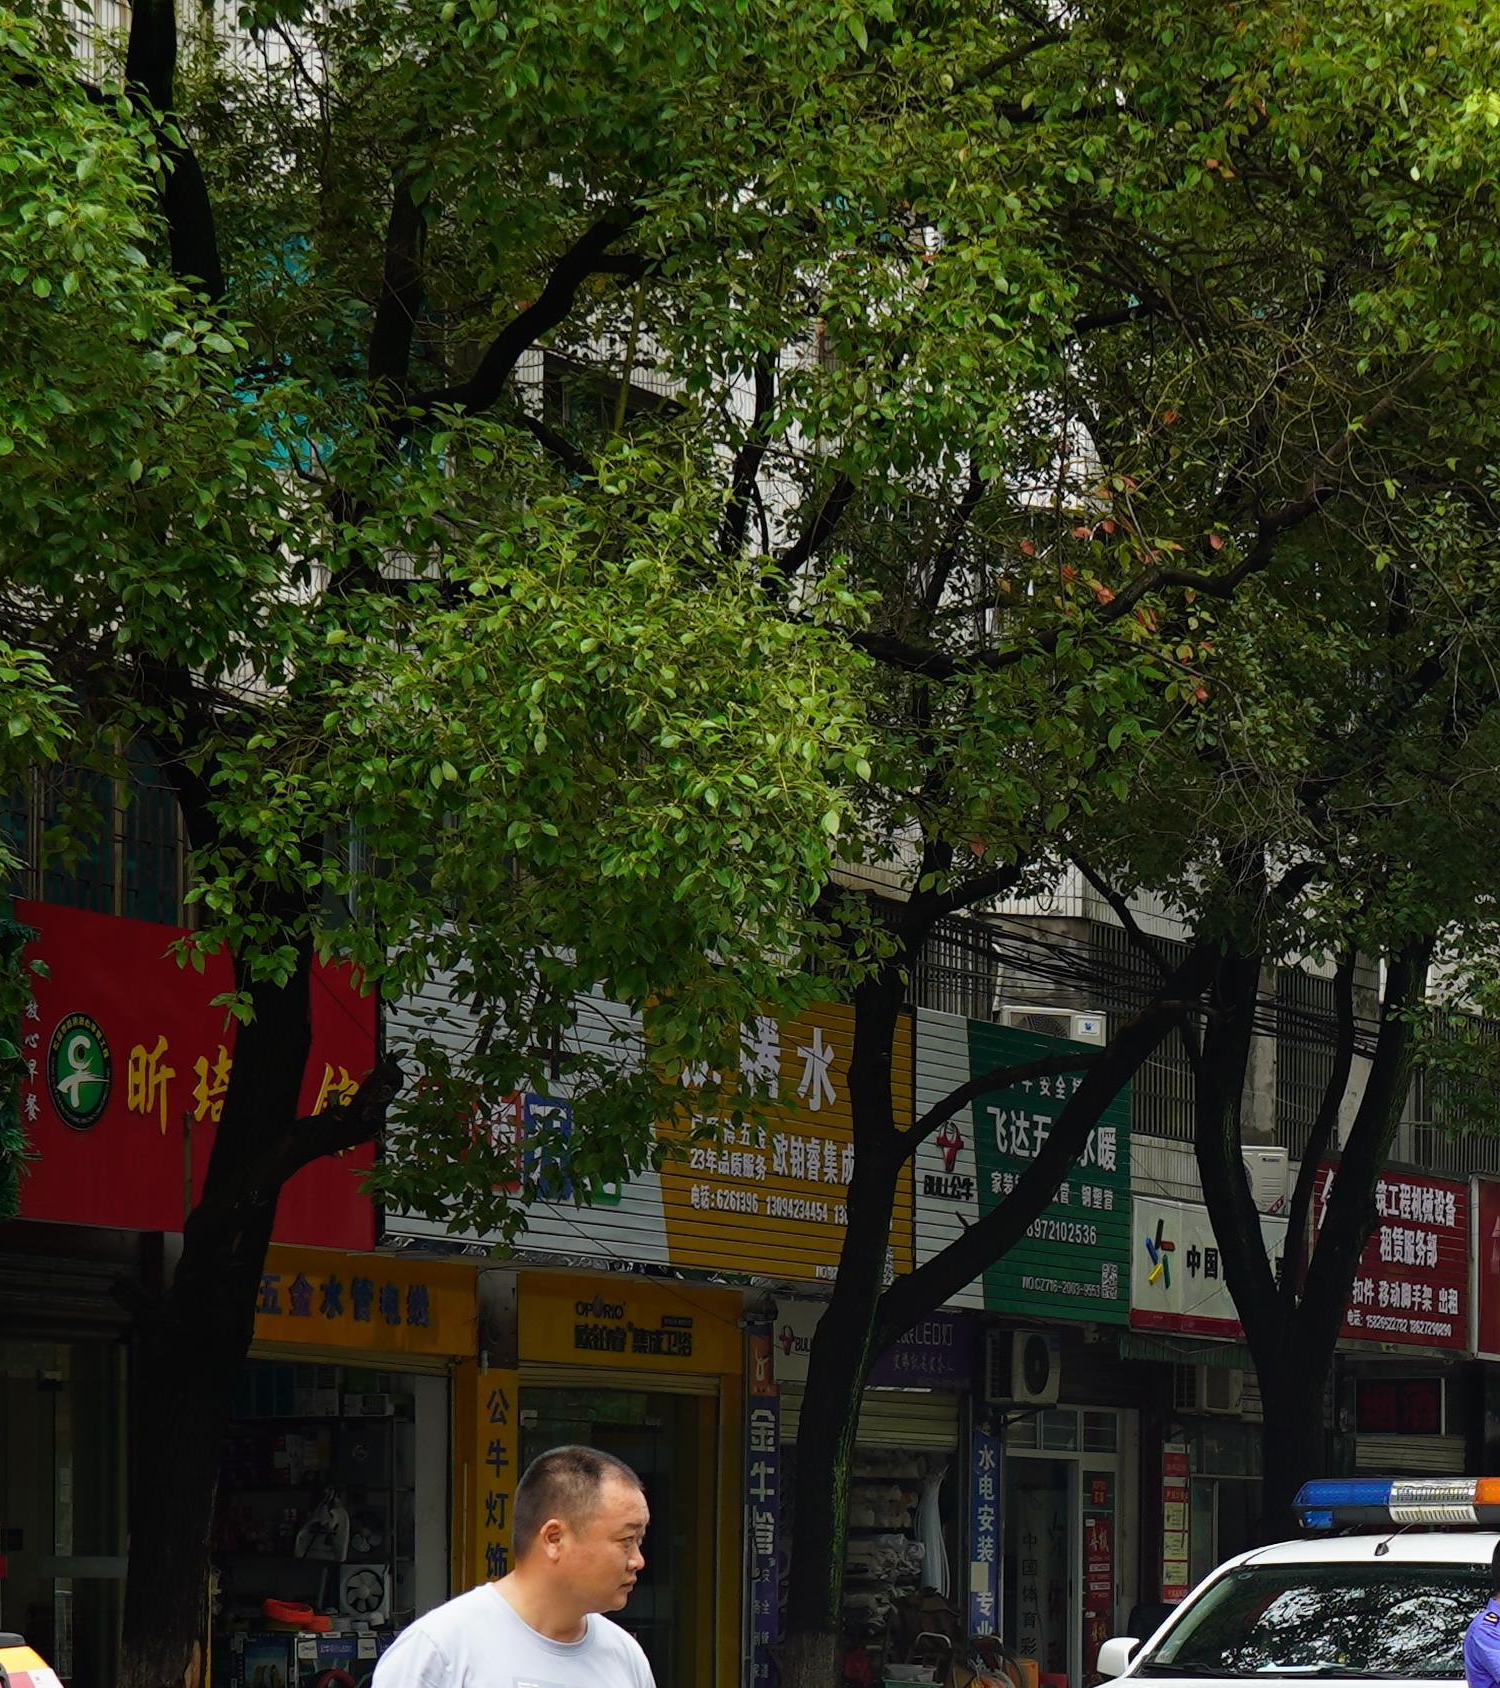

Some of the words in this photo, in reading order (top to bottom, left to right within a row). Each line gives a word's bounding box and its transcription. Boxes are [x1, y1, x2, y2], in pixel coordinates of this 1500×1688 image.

[690, 1148, 767, 1181] 23年品质服务
[485, 1389, 509, 1579] 公牛灯饰
